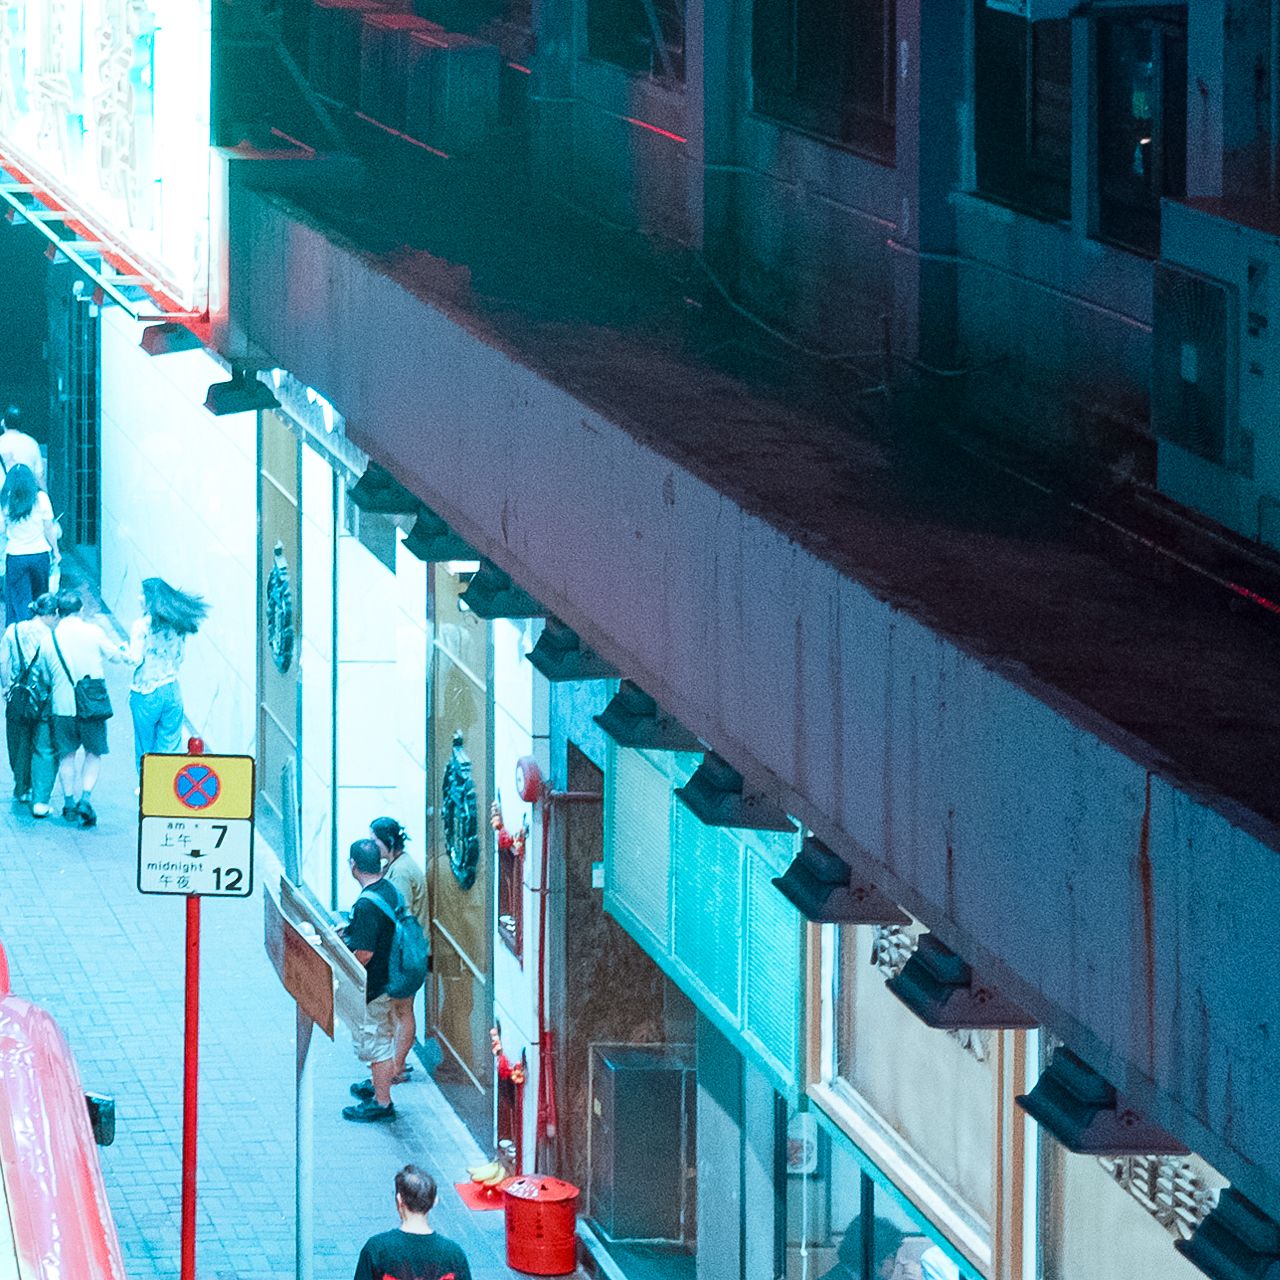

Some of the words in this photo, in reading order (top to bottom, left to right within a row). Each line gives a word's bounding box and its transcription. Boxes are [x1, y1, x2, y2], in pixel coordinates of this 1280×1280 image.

[160, 833, 192, 848] 上午
[211, 825, 228, 849] 7
[146, 861, 204, 873] midnight
[212, 867, 244, 891] 12
[159, 874, 191, 889] 午夜
